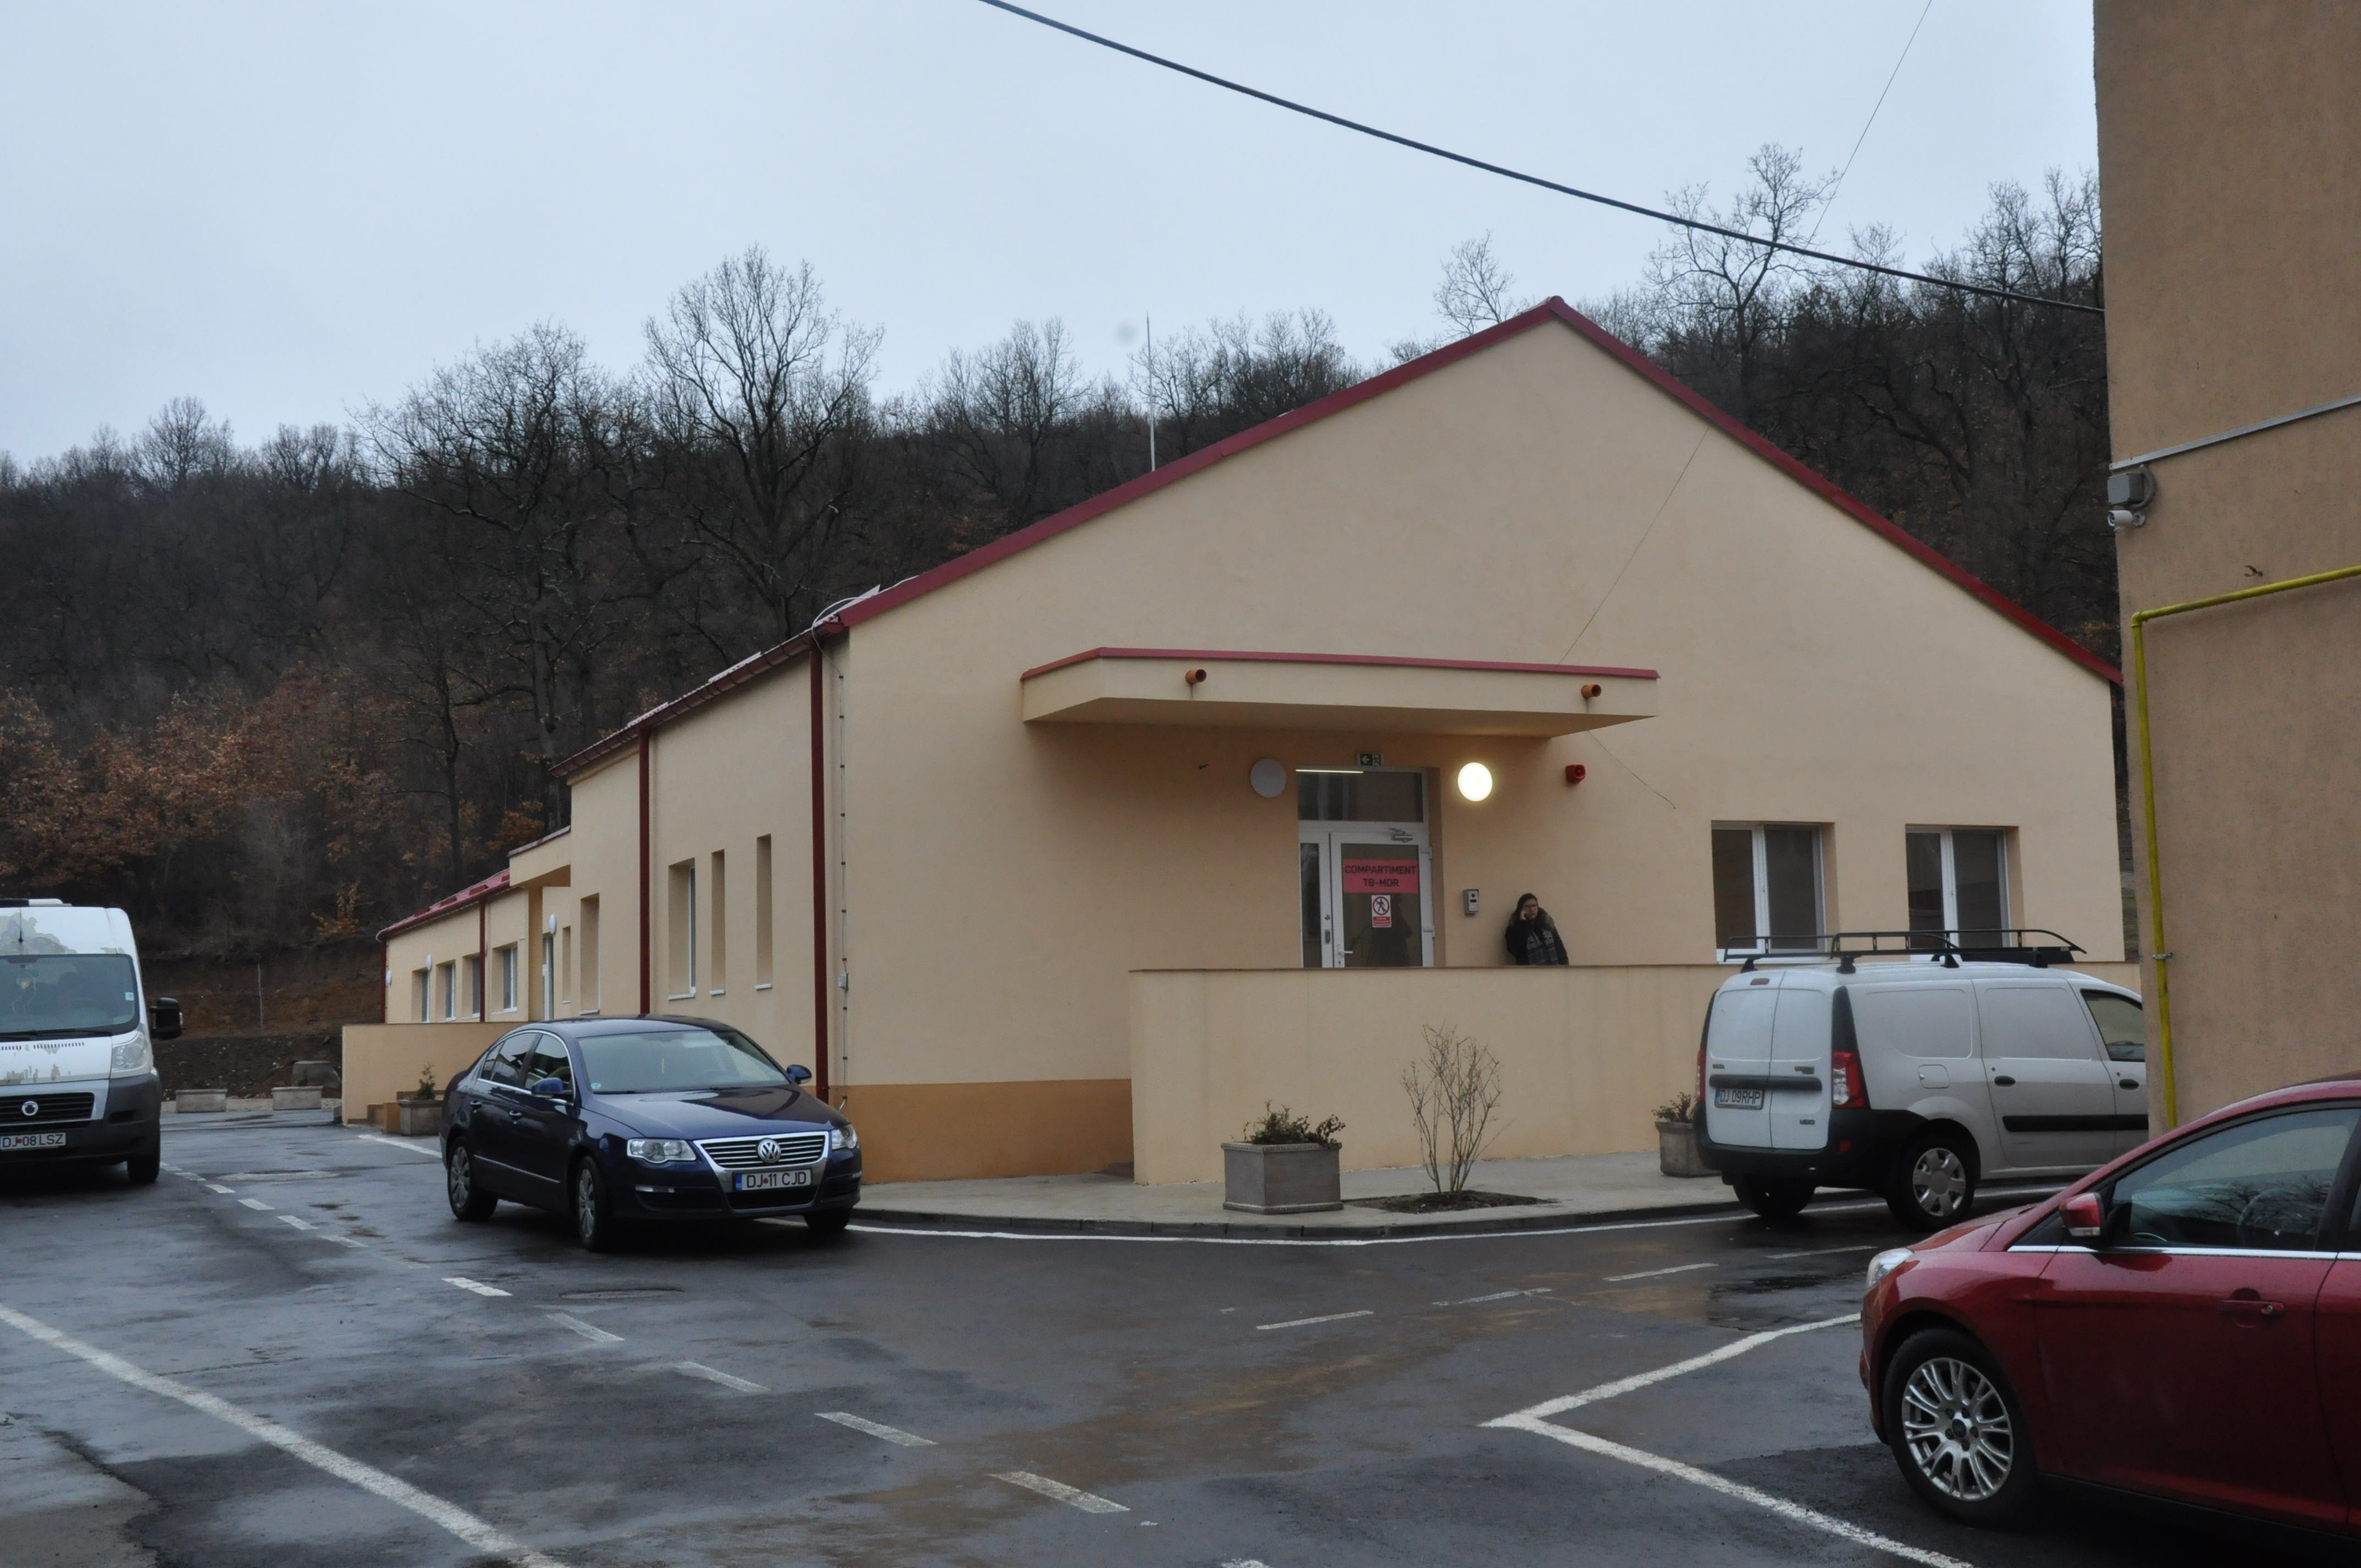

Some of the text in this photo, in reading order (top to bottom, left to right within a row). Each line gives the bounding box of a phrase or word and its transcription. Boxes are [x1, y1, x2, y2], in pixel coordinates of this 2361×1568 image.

[1345, 865, 1417, 874] COMPARTIMENT
[1363, 878, 1399, 886] TB-MDR
[2, 1134, 64, 1148] DJ 08 LSZ
[747, 1172, 807, 1188] DJ 11 CJD
